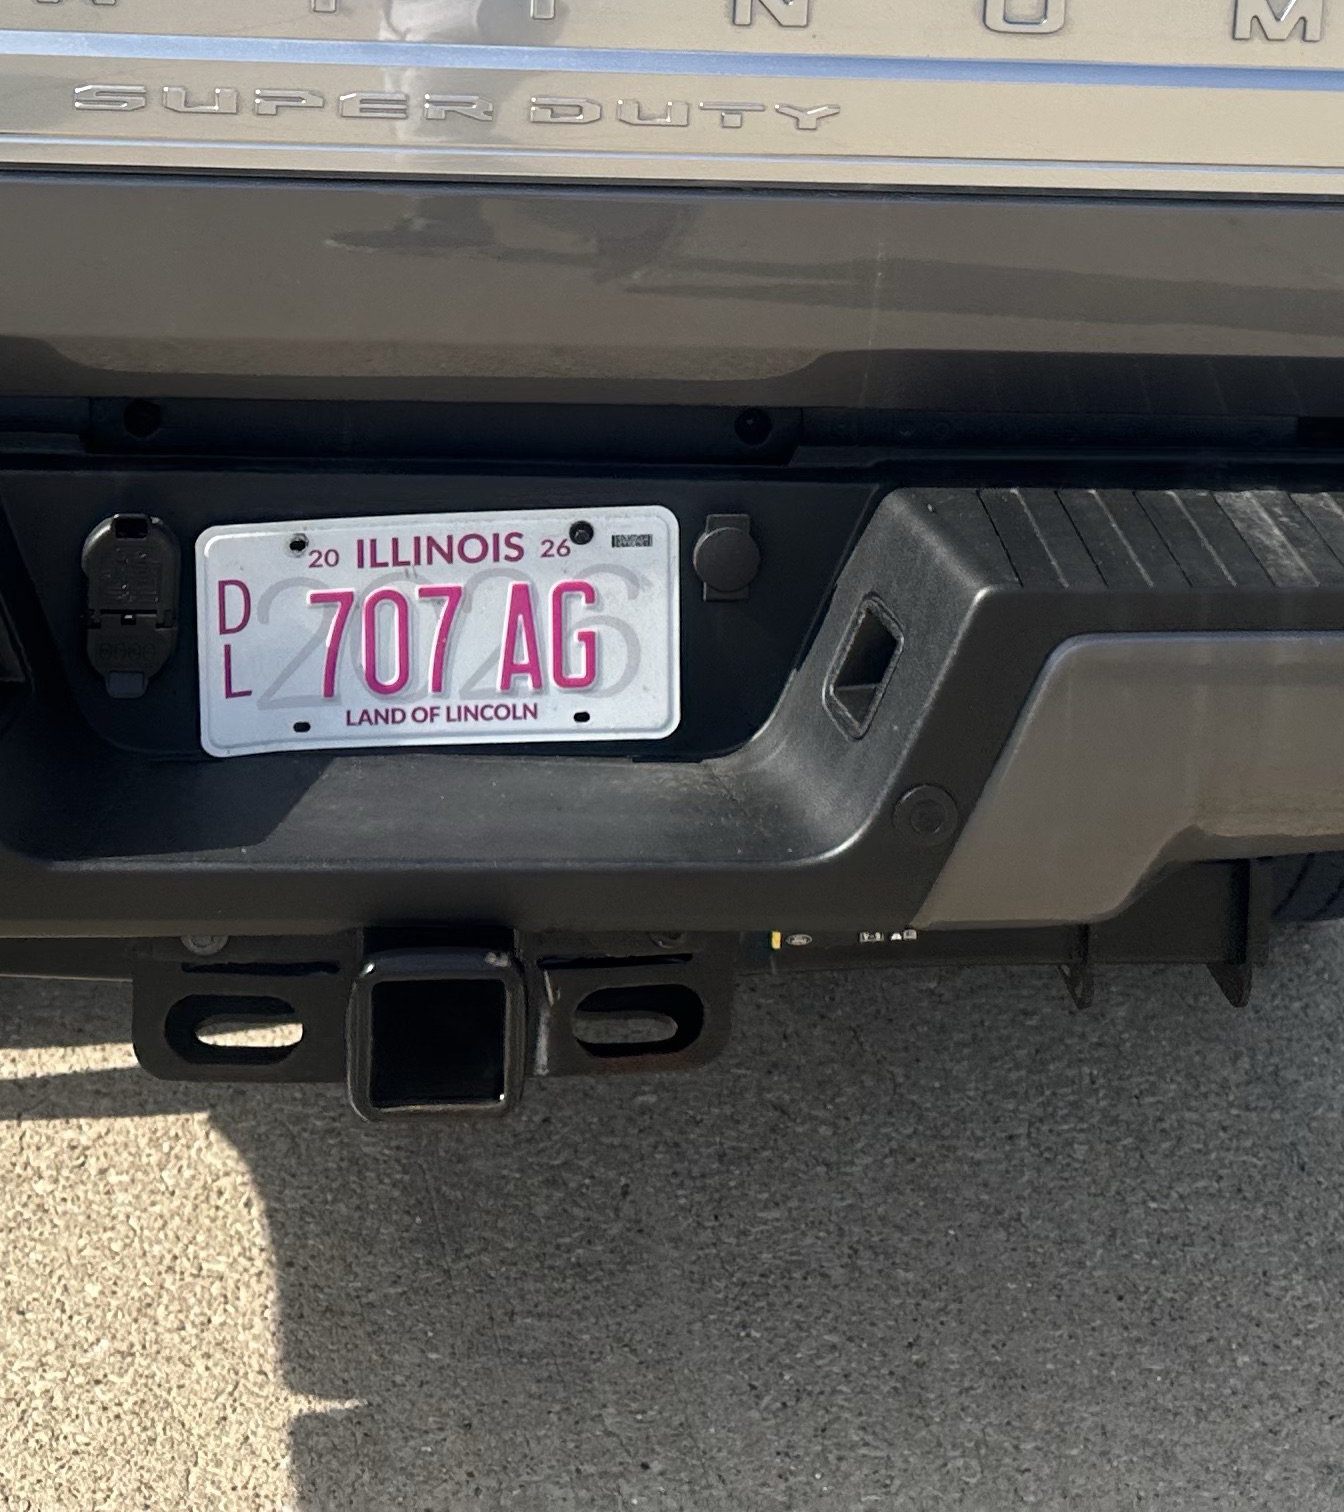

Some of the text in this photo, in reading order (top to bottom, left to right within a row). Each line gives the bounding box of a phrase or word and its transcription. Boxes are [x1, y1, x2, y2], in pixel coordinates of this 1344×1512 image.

[73, 82, 841, 131] SUPER DUTY
[308, 532, 571, 569] 20 ILLINOIS 26
[306, 579, 599, 699] 707 AG
[346, 703, 539, 727] LAND OF LINCOLN
